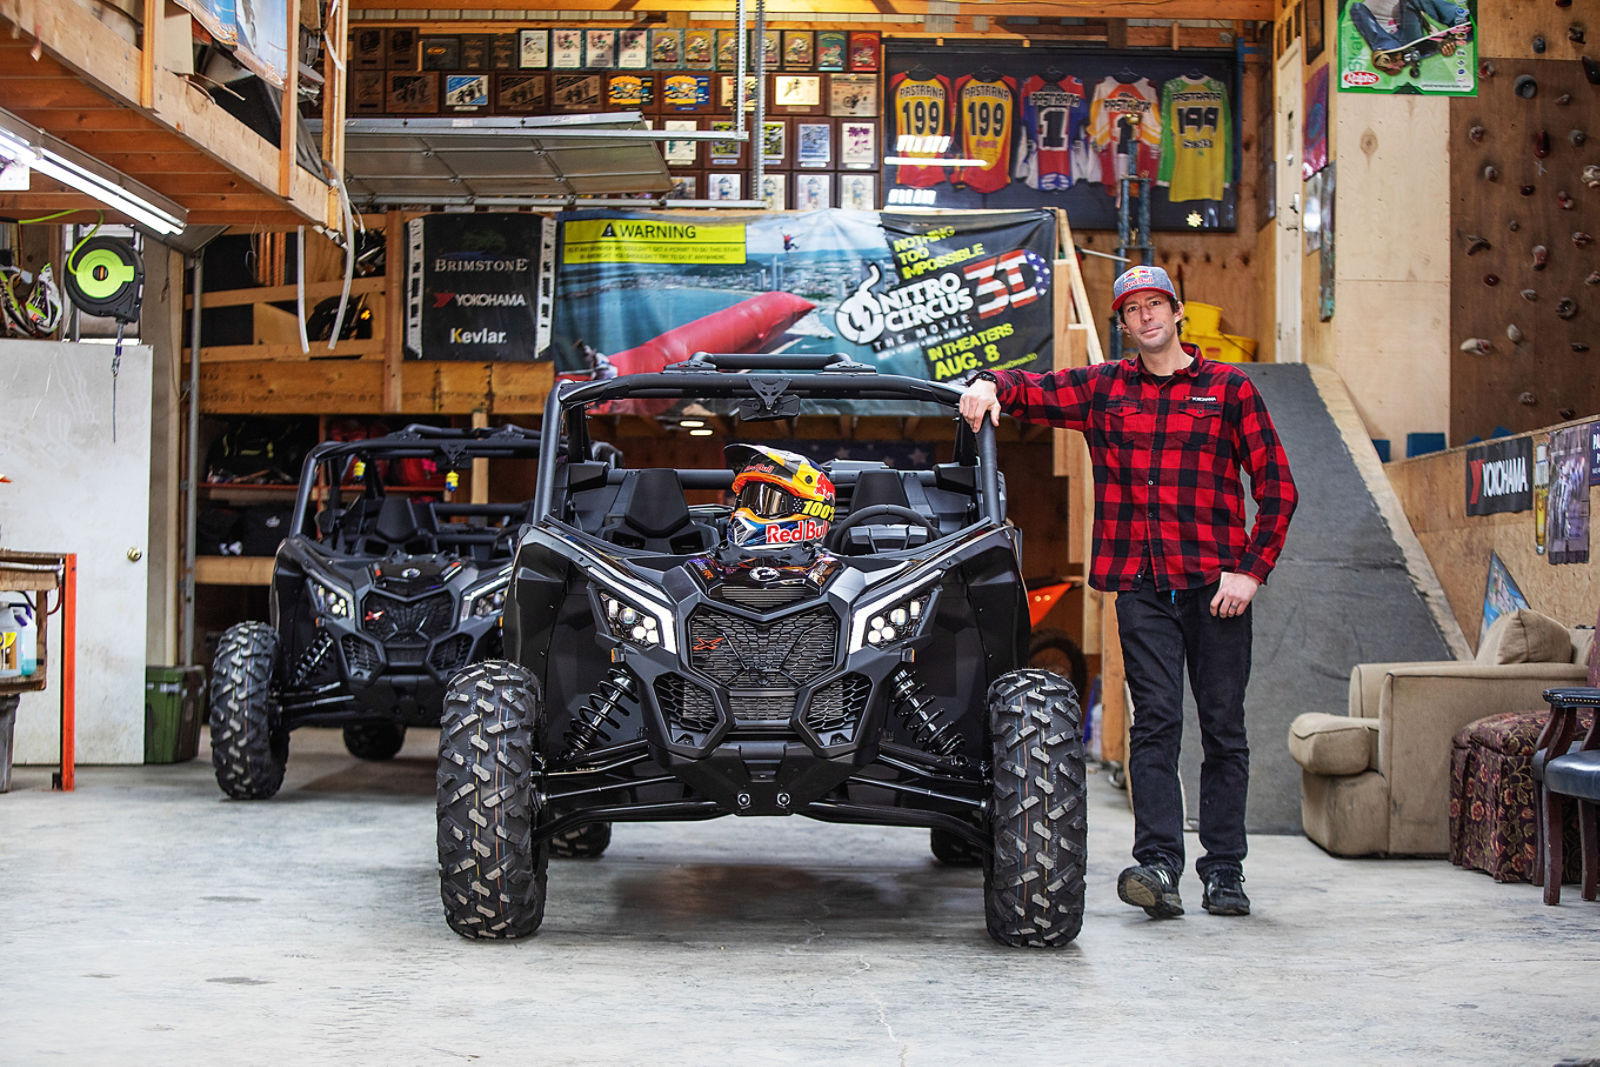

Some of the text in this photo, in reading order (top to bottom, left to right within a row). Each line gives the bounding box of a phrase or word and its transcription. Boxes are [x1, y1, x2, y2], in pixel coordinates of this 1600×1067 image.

[899, 84, 946, 99] PASTRANA
[963, 85, 1010, 101] PASTRANA
[1030, 92, 1081, 107] PASTRANA
[1172, 92, 1223, 102] PASTRANA
[902, 101, 941, 135] 199
[968, 102, 1005, 137] 199
[1038, 107, 1069, 151] 1
[1177, 107, 1219, 135] 199
[620, 224, 697, 239] WARNING
[893, 225, 956, 253] NOTHING
[434, 258, 529, 273] BRIMSTONE
[898, 247, 930, 266] TOO
[901, 243, 985, 280] IMPOSSIBLE
[455, 293, 526, 307] YOKOHAMA
[878, 272, 962, 315] NITRO
[884, 287, 974, 332] CIRCUS
[874, 332, 906, 351] THE
[914, 313, 971, 339] MOVIE
[927, 346, 944, 362] IN
[942, 322, 1015, 357] THEATERS
[935, 351, 983, 381] AUG.
[983, 343, 1000, 363] 8
[1482, 456, 1529, 498] YOKOHAMA
[802, 500, 835, 522] 100%
[766, 520, 804, 544] Red
